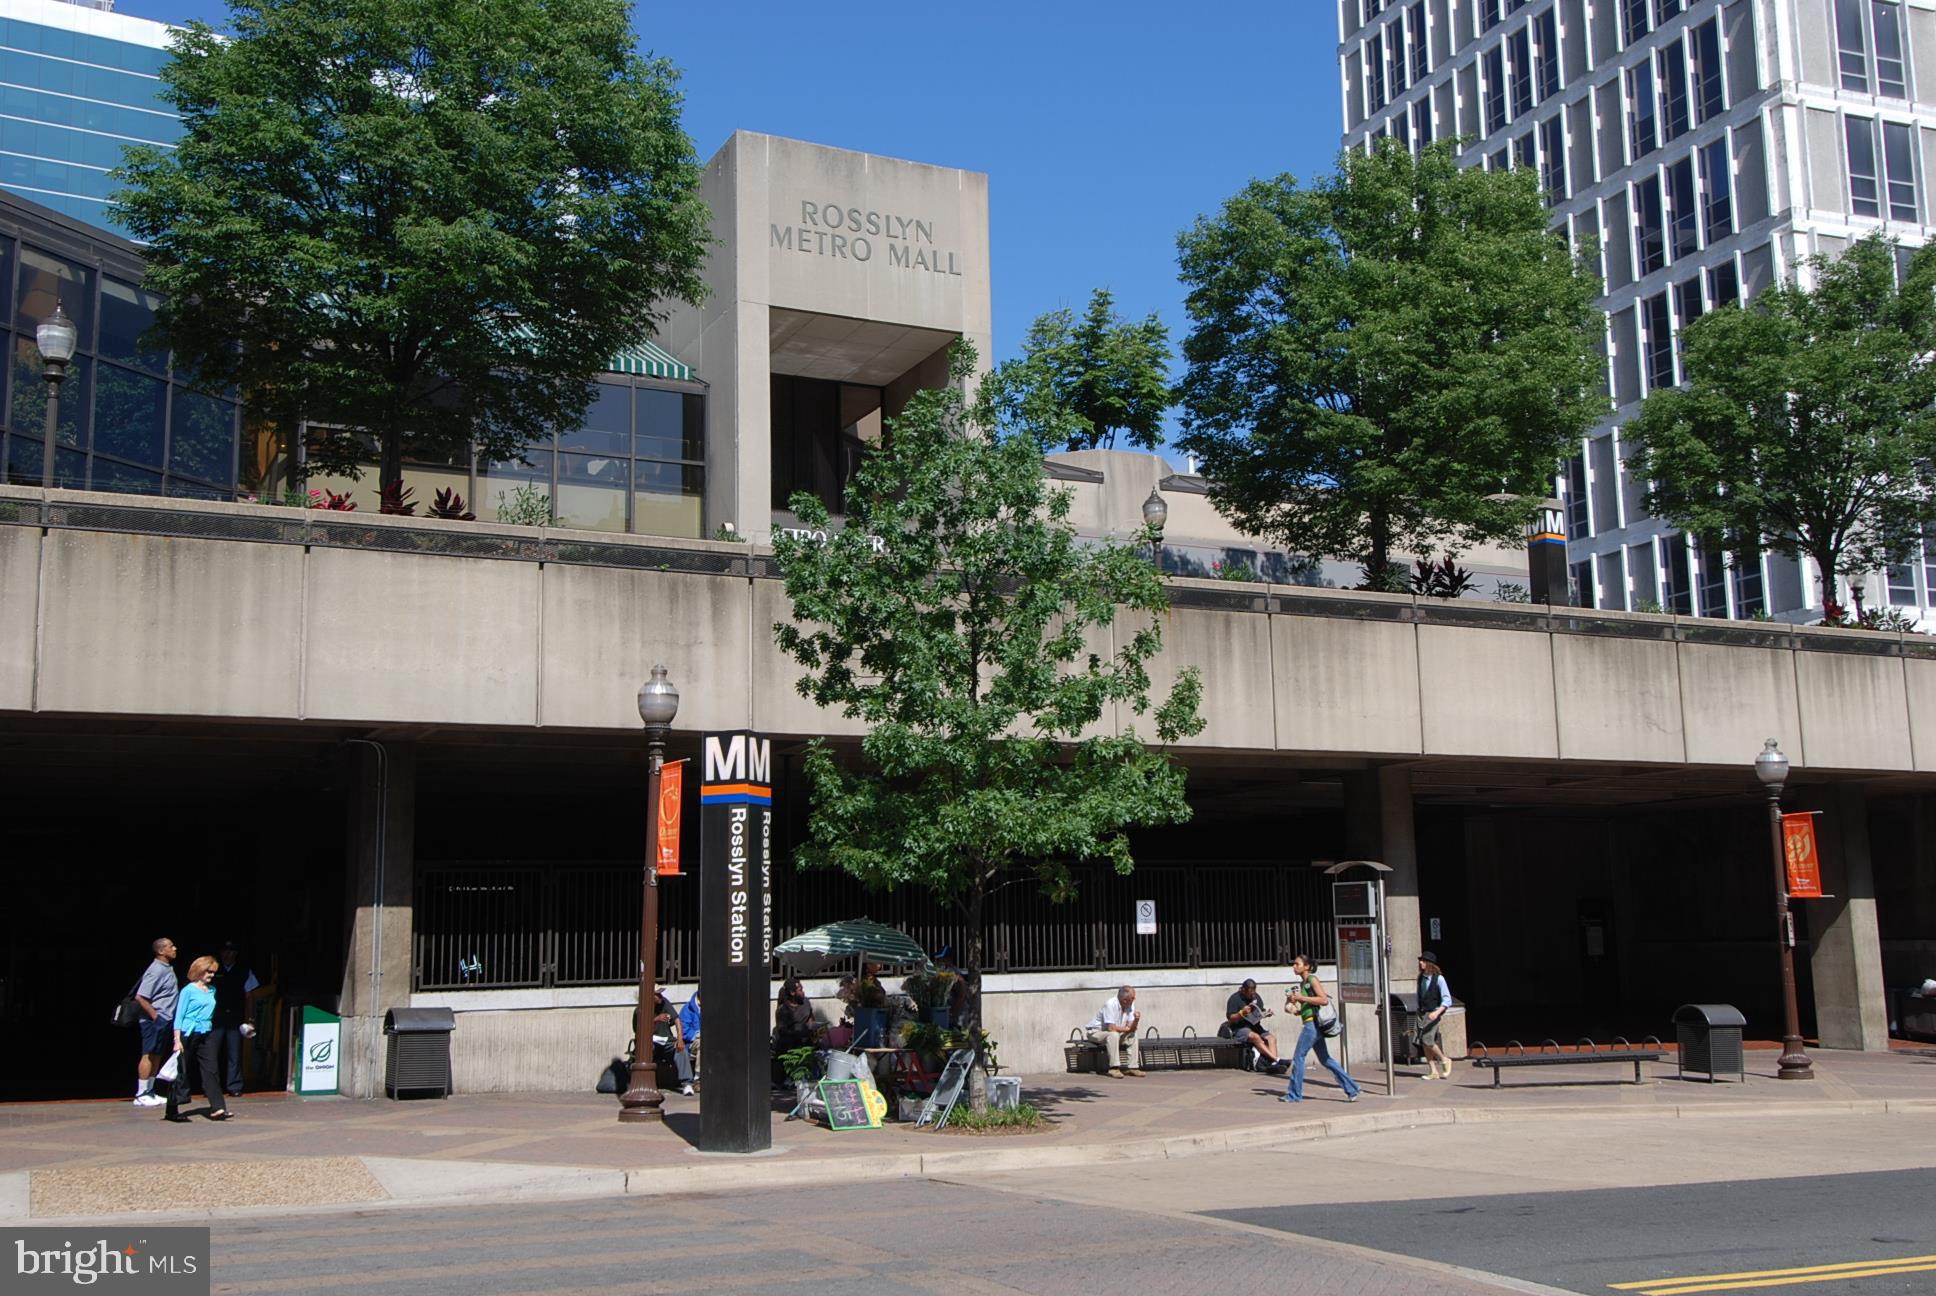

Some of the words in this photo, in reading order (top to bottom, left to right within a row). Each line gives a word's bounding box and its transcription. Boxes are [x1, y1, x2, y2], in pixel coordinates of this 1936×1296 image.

[801, 200, 933, 244] ROSSLYN
[770, 223, 872, 262] METRO
[888, 243, 962, 276] MALL
[1545, 510, 1564, 534] M
[705, 735, 746, 782] M
[749, 736, 771, 784] M
[728, 807, 747, 886] Rosslyn
[761, 811, 771, 888] Rosslyn
[731, 891, 747, 963] Station
[763, 893, 772, 964] Station
